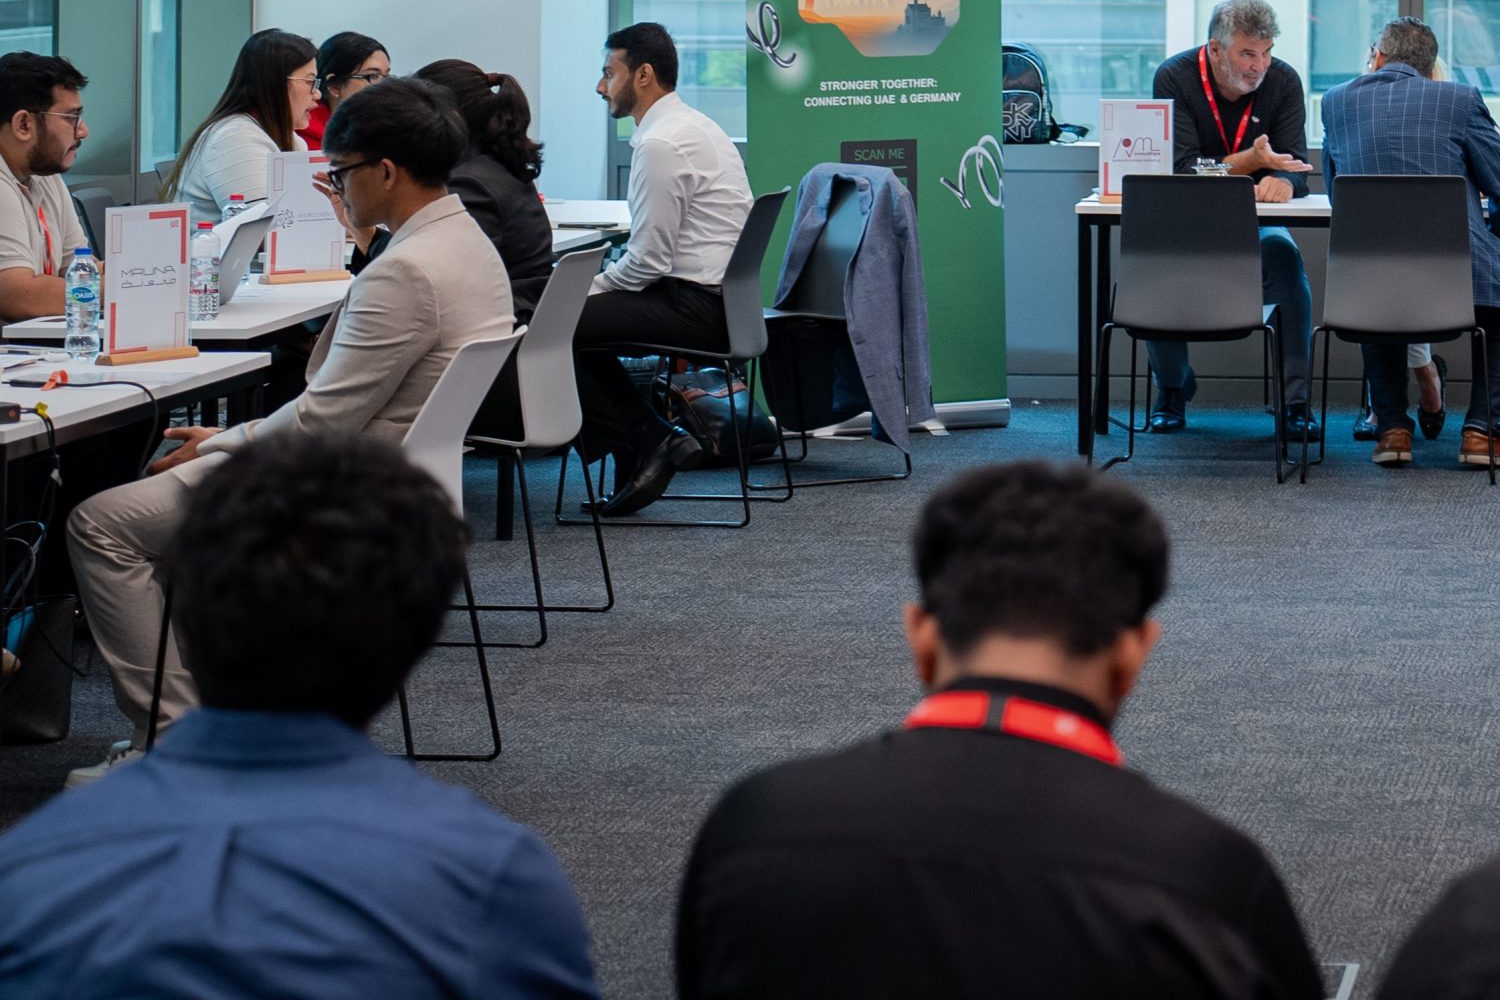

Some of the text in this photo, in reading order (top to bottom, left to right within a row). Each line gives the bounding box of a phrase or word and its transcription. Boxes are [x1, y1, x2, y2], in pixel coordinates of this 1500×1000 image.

[819, 78, 938, 91] STRONGER TOGETHER:
[804, 92, 961, 107] CONNECTING UAE & GERMANY
[854, 148, 904, 161] SCAN ME
